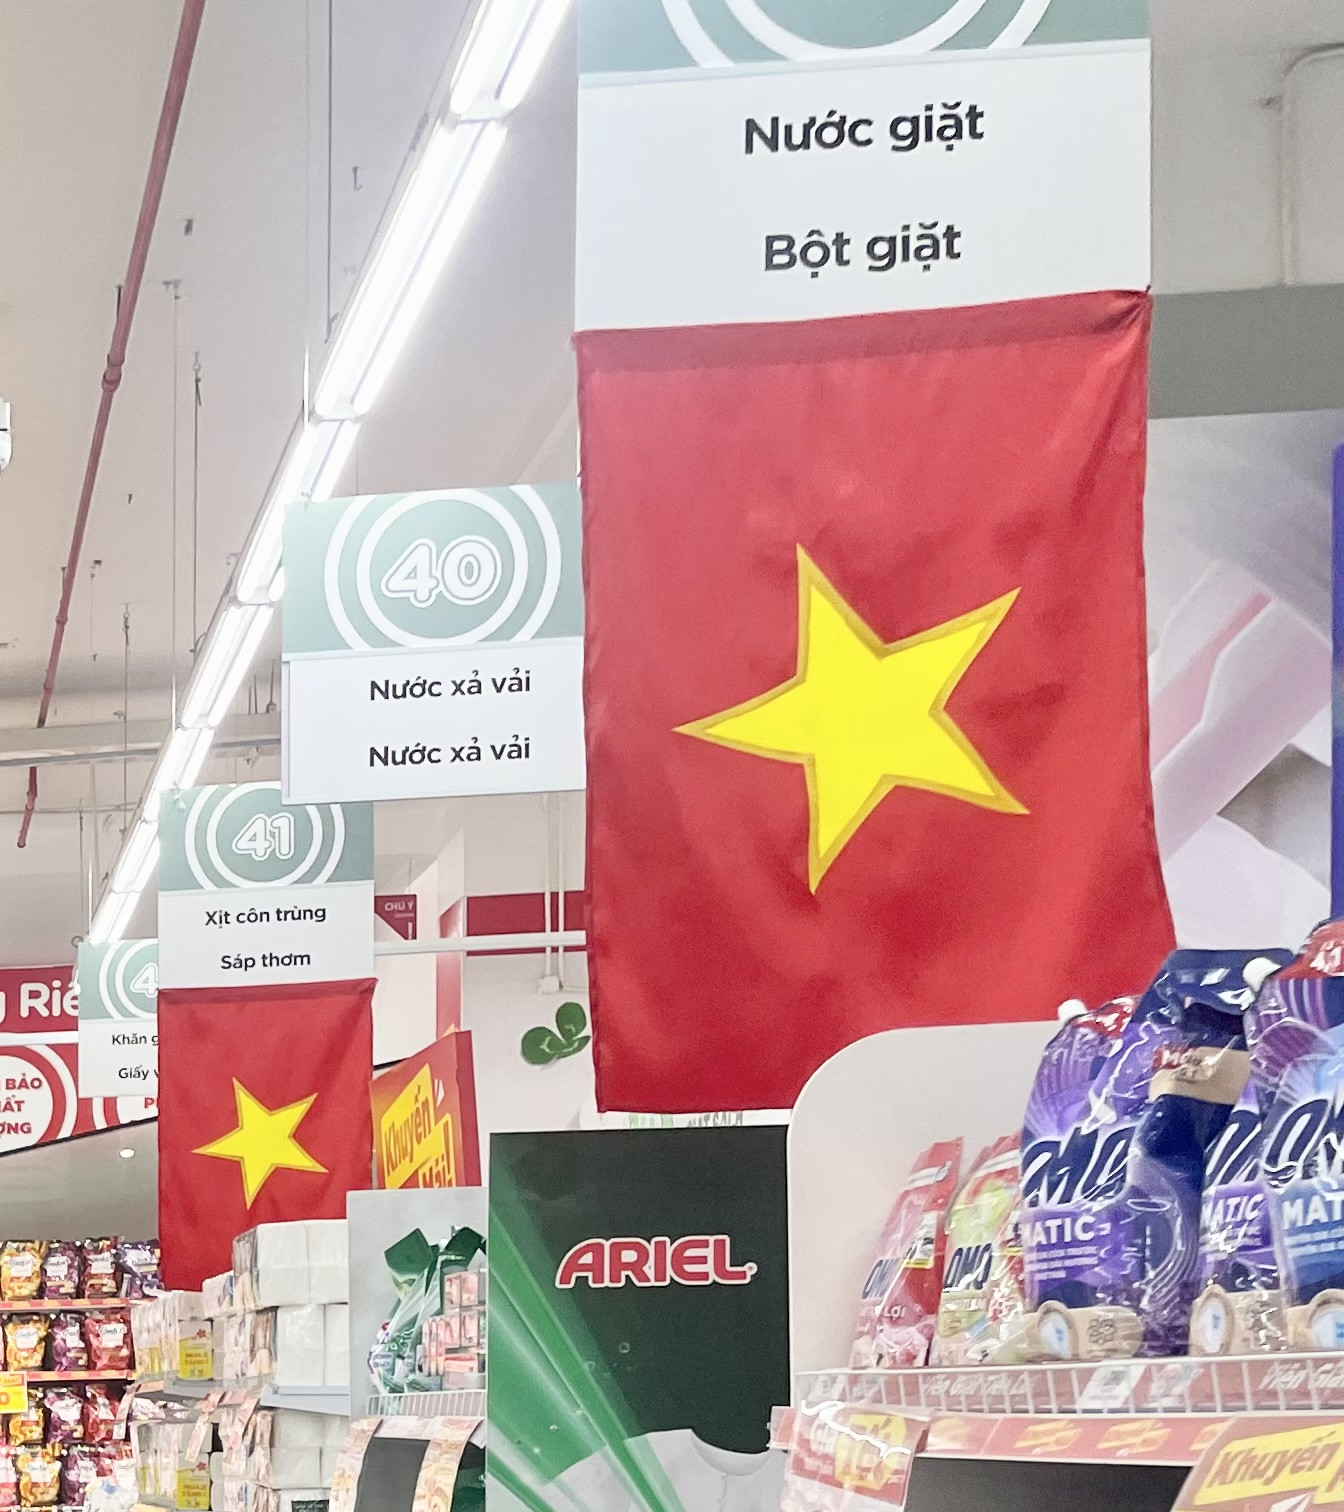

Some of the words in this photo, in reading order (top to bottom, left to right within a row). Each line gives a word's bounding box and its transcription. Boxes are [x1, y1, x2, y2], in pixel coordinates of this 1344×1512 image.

[744, 109, 874, 154] Nước
[889, 100, 985, 152] giặt
[764, 229, 851, 279] Bột
[866, 220, 962, 272] giặt
[381, 535, 502, 608] 40
[370, 674, 443, 701] Nước
[449, 669, 483, 698] xả
[491, 667, 532, 694] vải
[369, 742, 443, 768] Nước
[449, 737, 482, 762] xả
[491, 734, 531, 760] vải
[232, 812, 294, 861] 41
[204, 908, 230, 930] Xịt
[235, 907, 271, 926] côn
[275, 904, 328, 929] trùng
[220, 951, 257, 974] Sáp
[261, 949, 312, 969] thơm
[111, 1031, 148, 1048] Khăn
[8, 1072, 43, 1092] BẢO
[118, 1064, 151, 1082] Giấy
[382, 1084, 433, 1180] Khuyến
[556, 1235, 750, 1288] ARIEL
[1206, 1430, 1332, 1490] Khuyến
